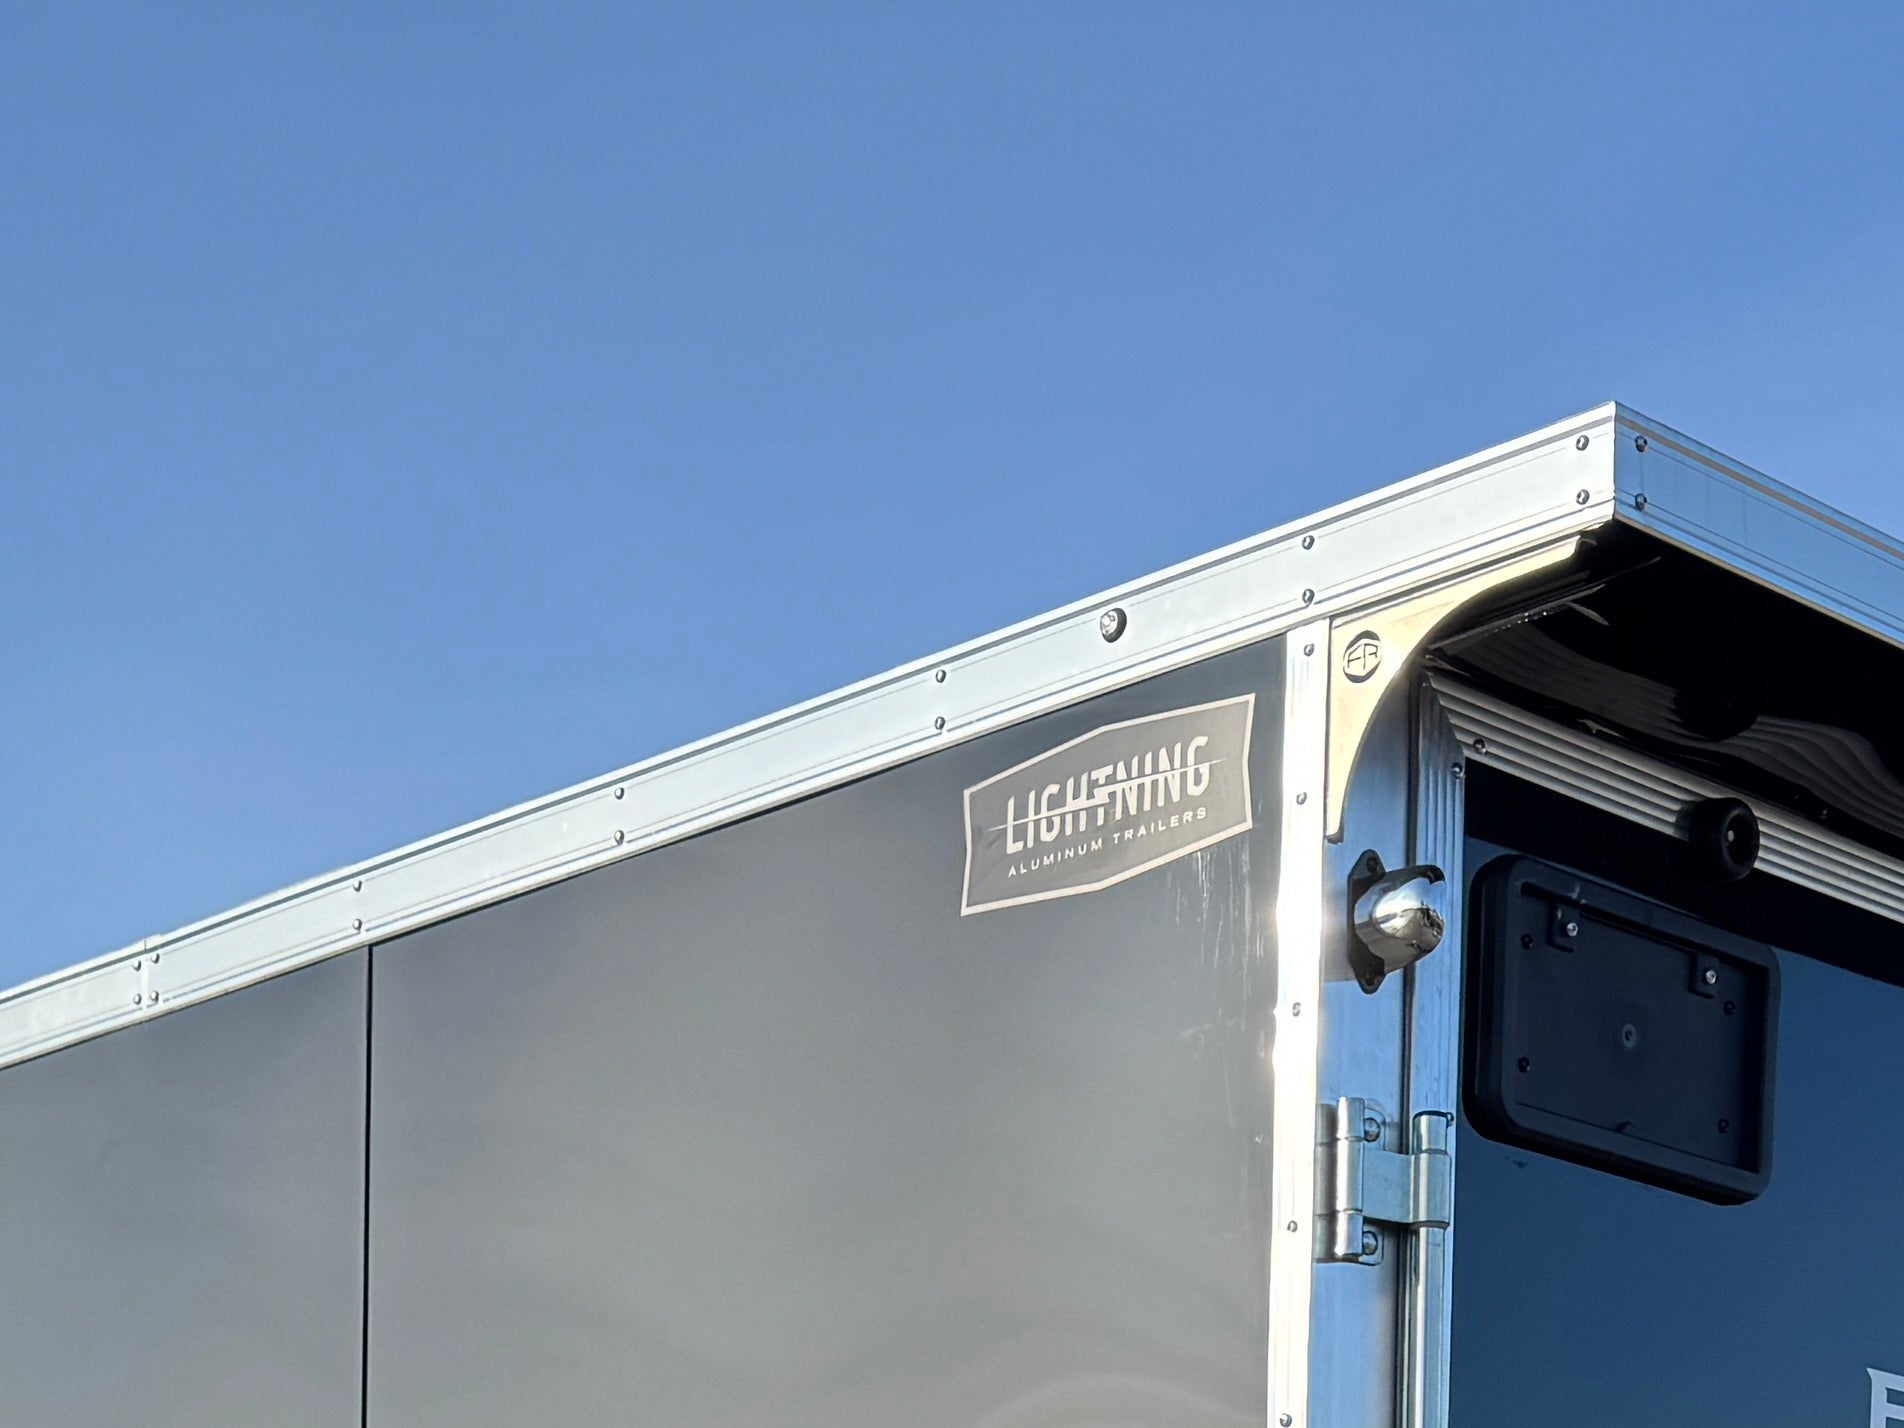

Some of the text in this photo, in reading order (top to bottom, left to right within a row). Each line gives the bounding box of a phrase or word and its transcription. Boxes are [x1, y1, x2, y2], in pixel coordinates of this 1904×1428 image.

[1005, 735, 1211, 856] LIGHTNING
[1008, 806, 1208, 878] ALUMINUM TRAILERS
